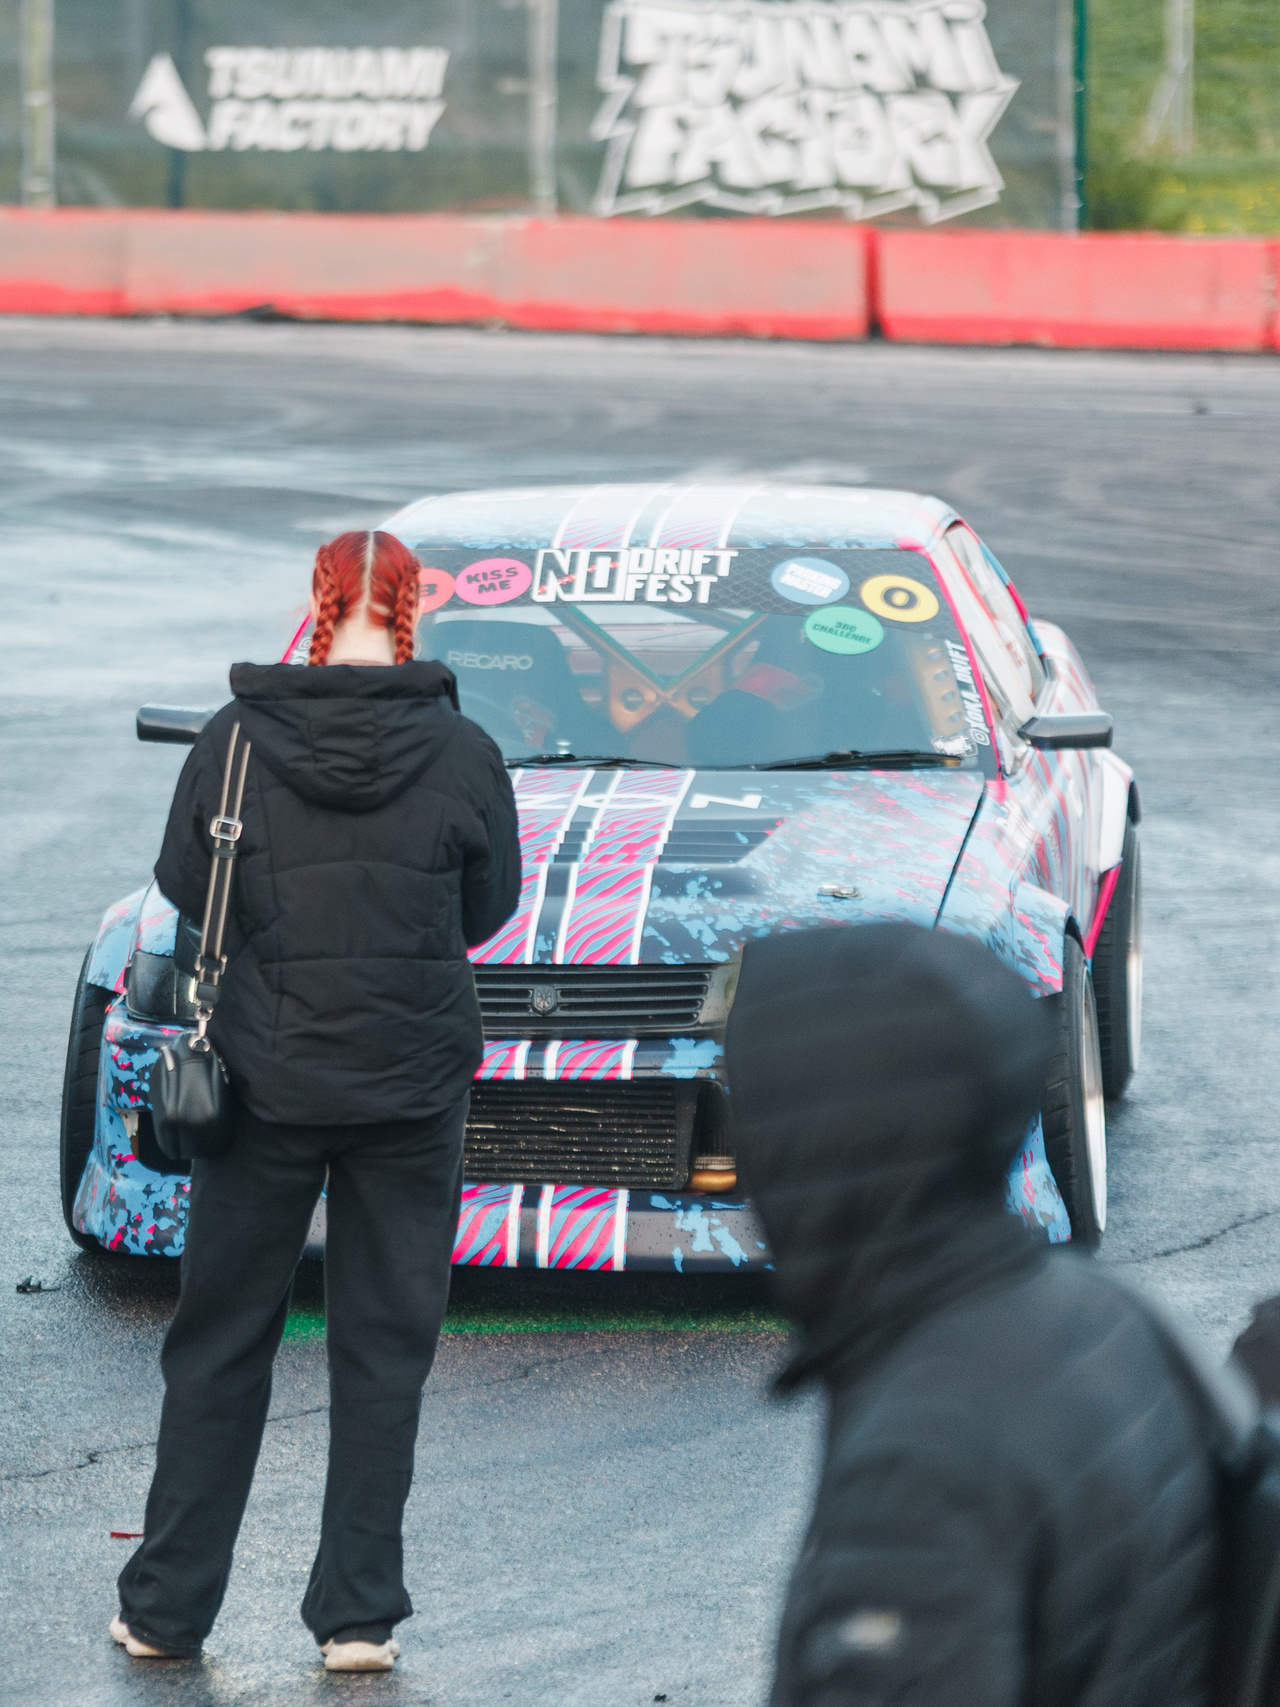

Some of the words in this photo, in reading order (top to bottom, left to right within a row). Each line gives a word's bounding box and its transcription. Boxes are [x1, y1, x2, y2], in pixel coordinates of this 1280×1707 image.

[204, 46, 451, 99] TSUNAMI
[207, 99, 448, 151] FACTORY
[628, 549, 739, 577] DRIFT
[466, 567, 519, 585] KISS
[478, 580, 512, 594] ME
[624, 574, 719, 604] FEST
[812, 623, 874, 646] CHALLENGE
[447, 650, 534, 670] RECARO
